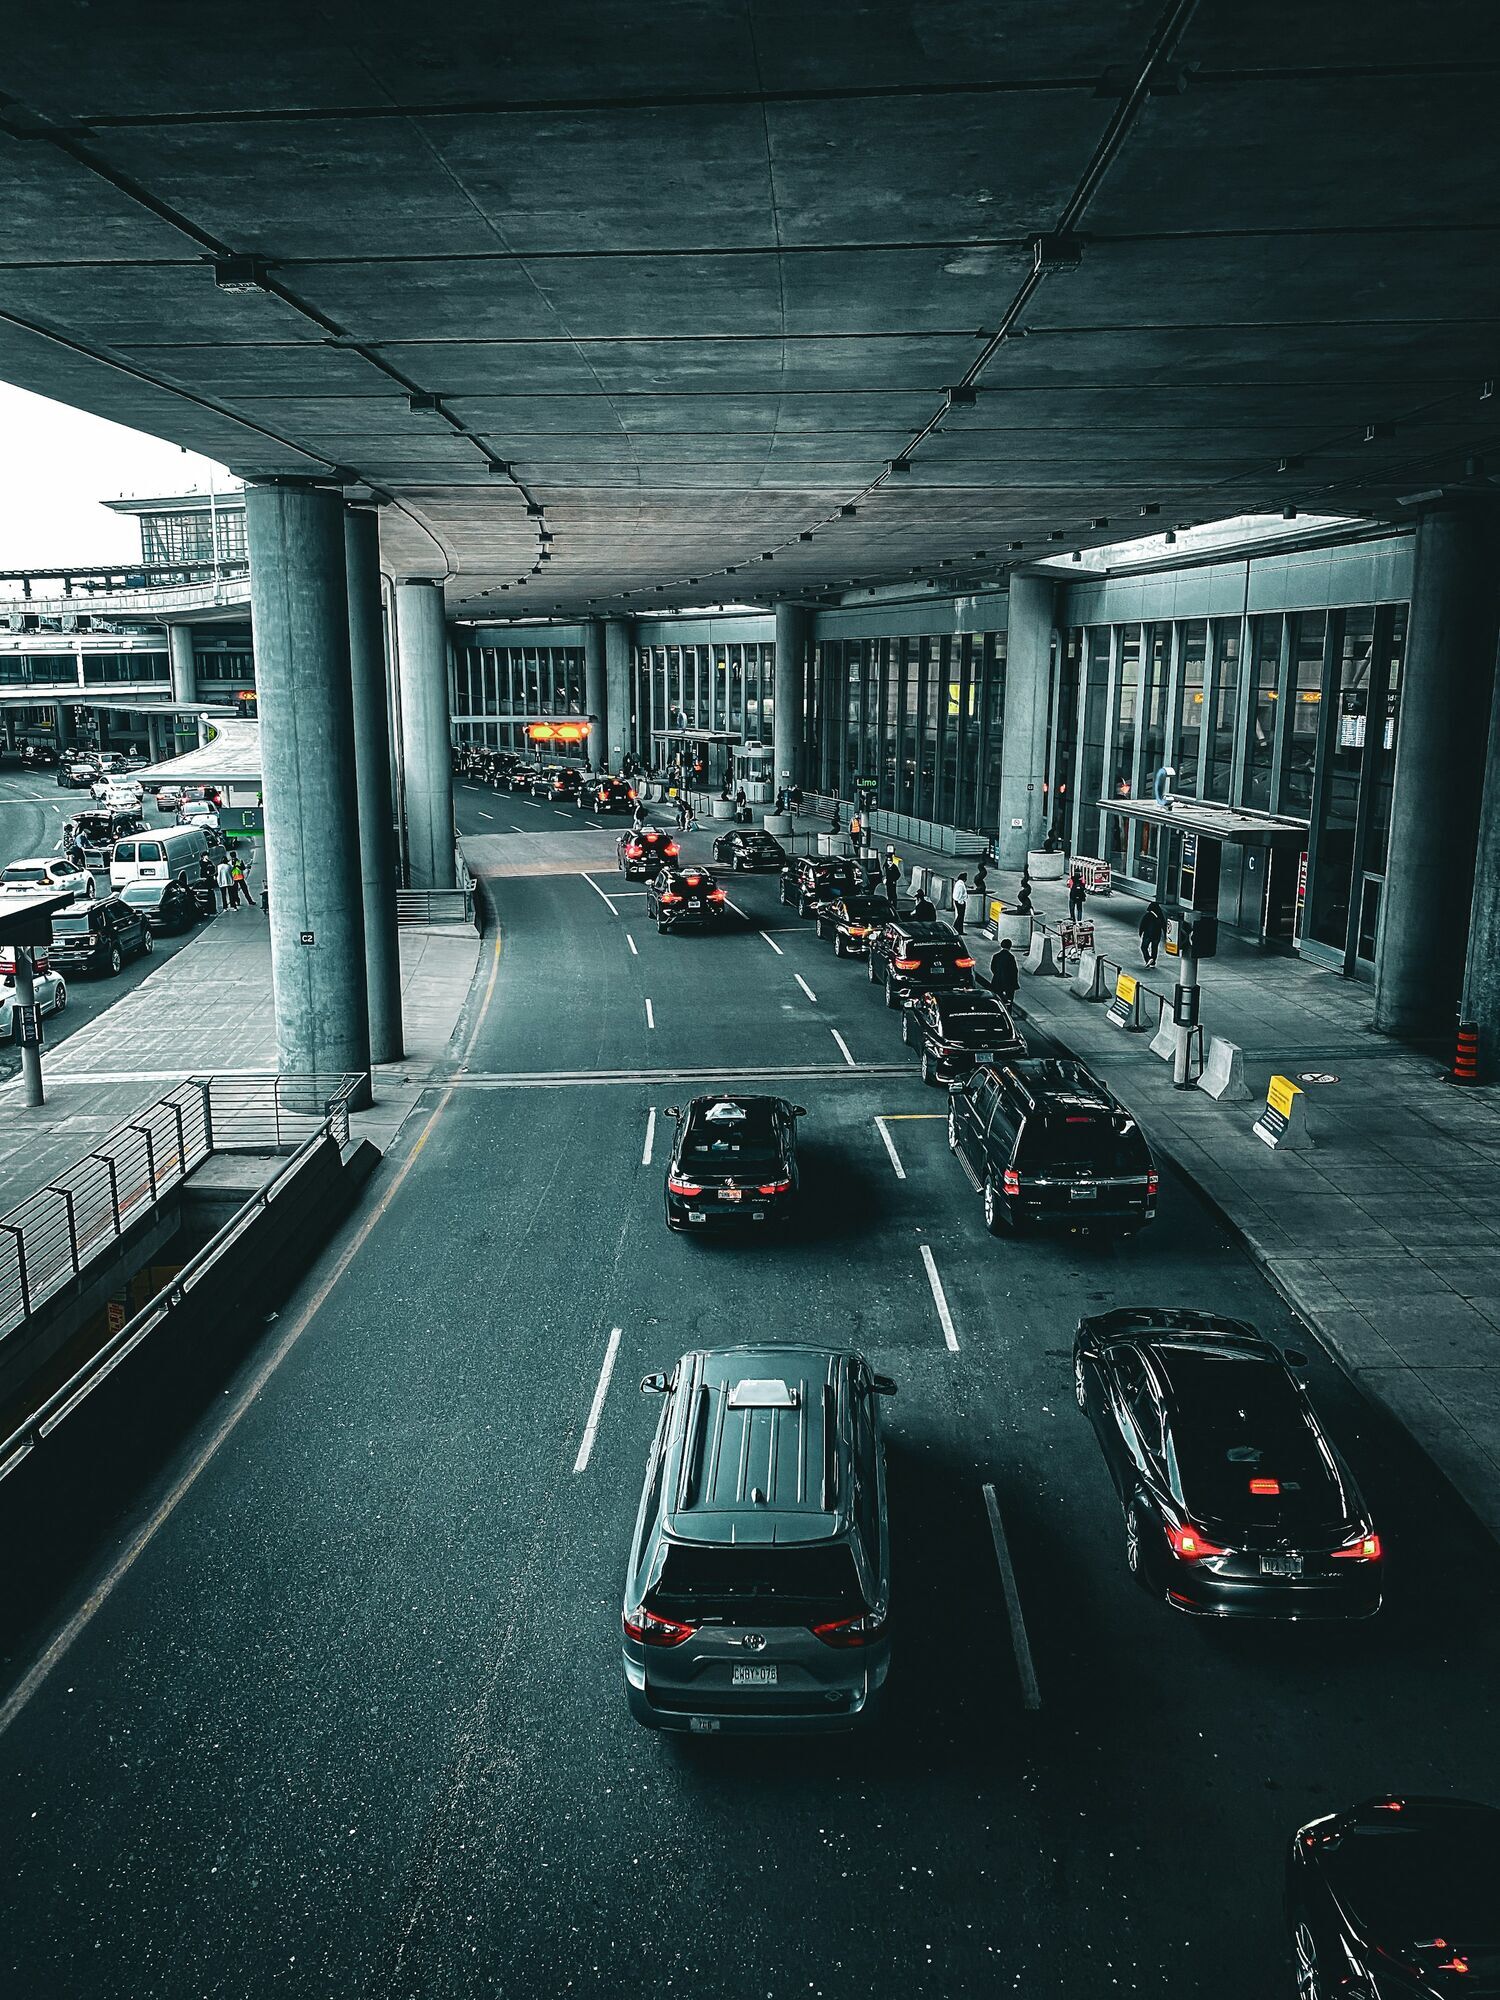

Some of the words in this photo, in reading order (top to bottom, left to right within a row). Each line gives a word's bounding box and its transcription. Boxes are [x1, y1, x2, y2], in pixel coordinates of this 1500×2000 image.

[856, 778, 877, 786] Limo
[242, 810, 256, 828] C
[1248, 856, 1255, 870] C
[302, 935, 313, 943] C2
